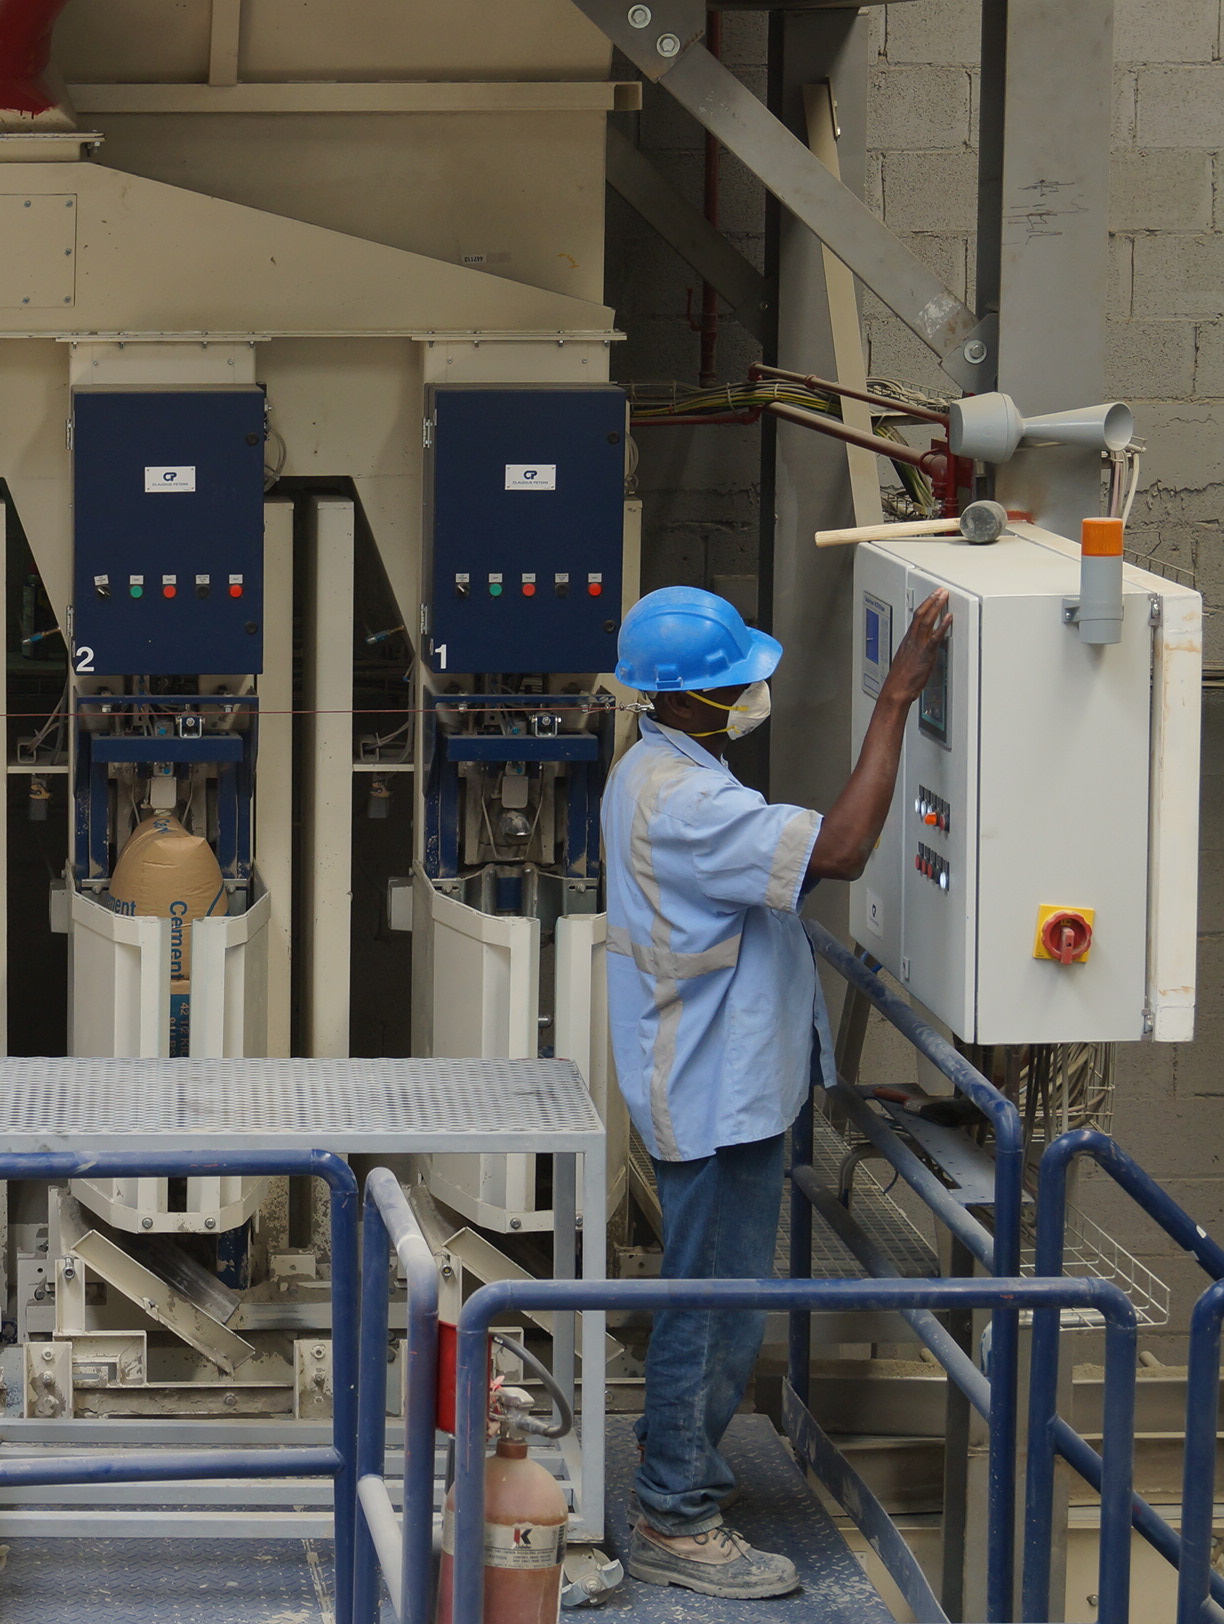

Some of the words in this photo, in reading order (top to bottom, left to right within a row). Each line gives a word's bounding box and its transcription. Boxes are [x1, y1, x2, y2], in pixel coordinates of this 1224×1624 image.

[75, 646, 94, 671] 2
[434, 644, 447, 669] 1
[169, 901, 188, 980] Cement
[180, 1002, 189, 1015] 42
